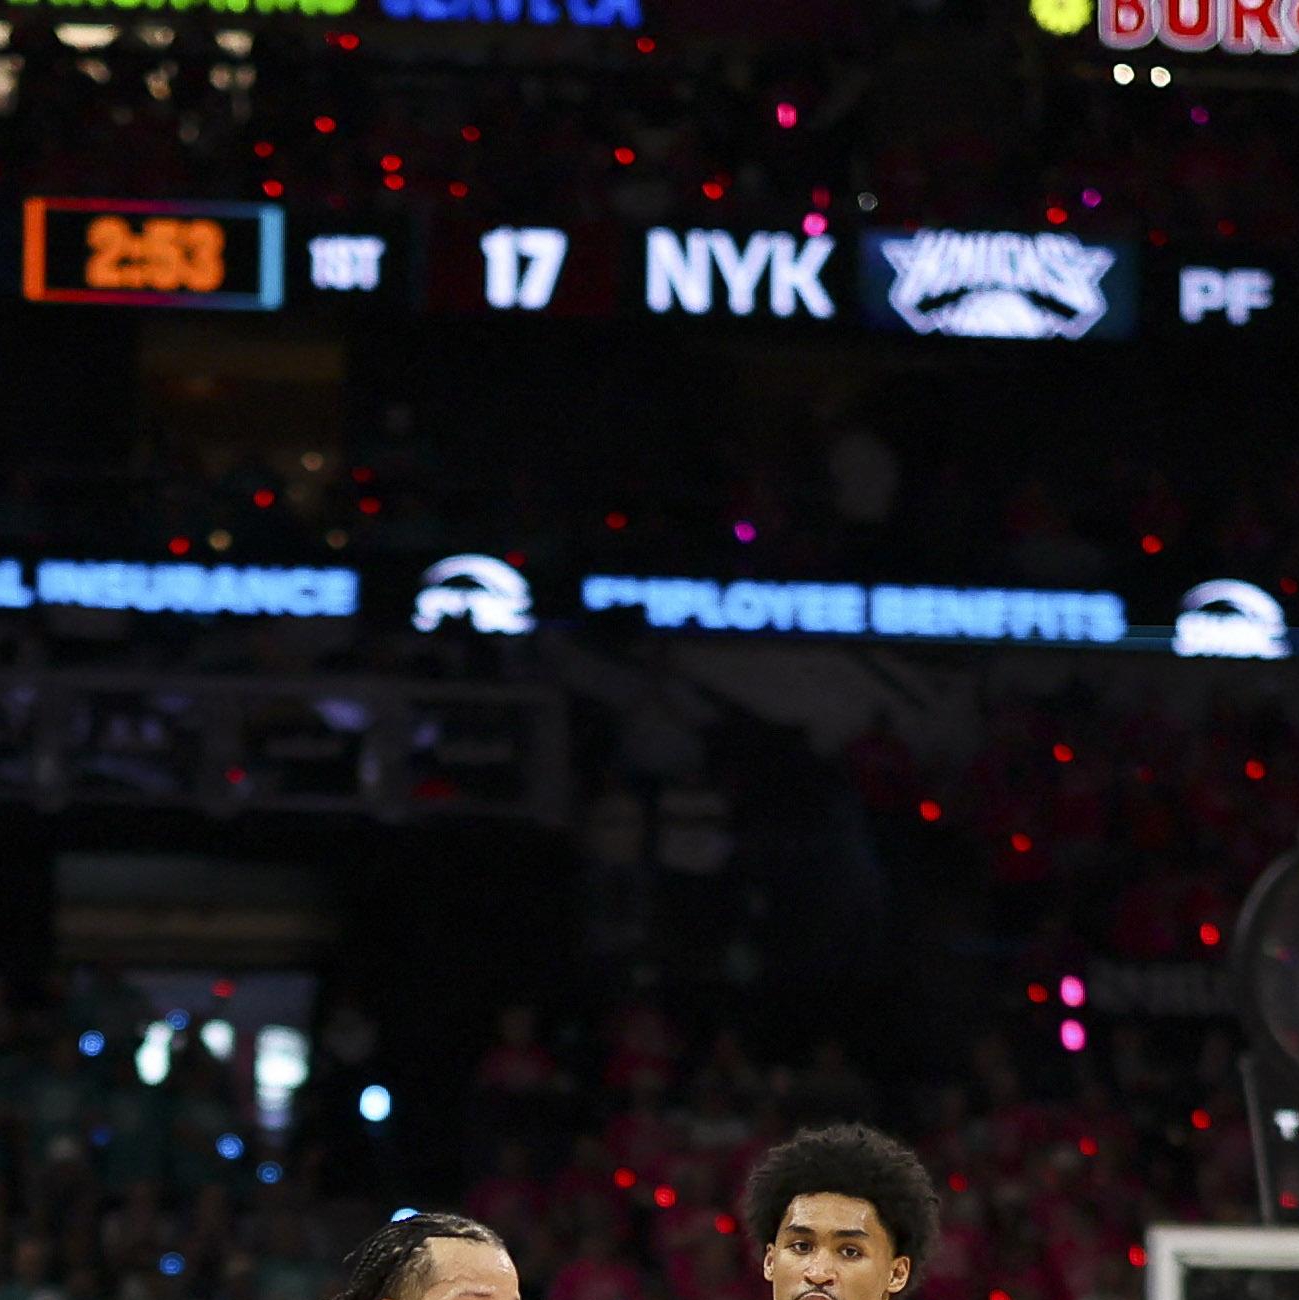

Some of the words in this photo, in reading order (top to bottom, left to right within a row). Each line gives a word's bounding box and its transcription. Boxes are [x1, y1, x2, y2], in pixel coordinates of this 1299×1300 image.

[481, 227, 568, 310] 17
[646, 227, 835, 318] NYK
[1180, 267, 1272, 324] PF
[870, 584, 1129, 644] BENEFITS
